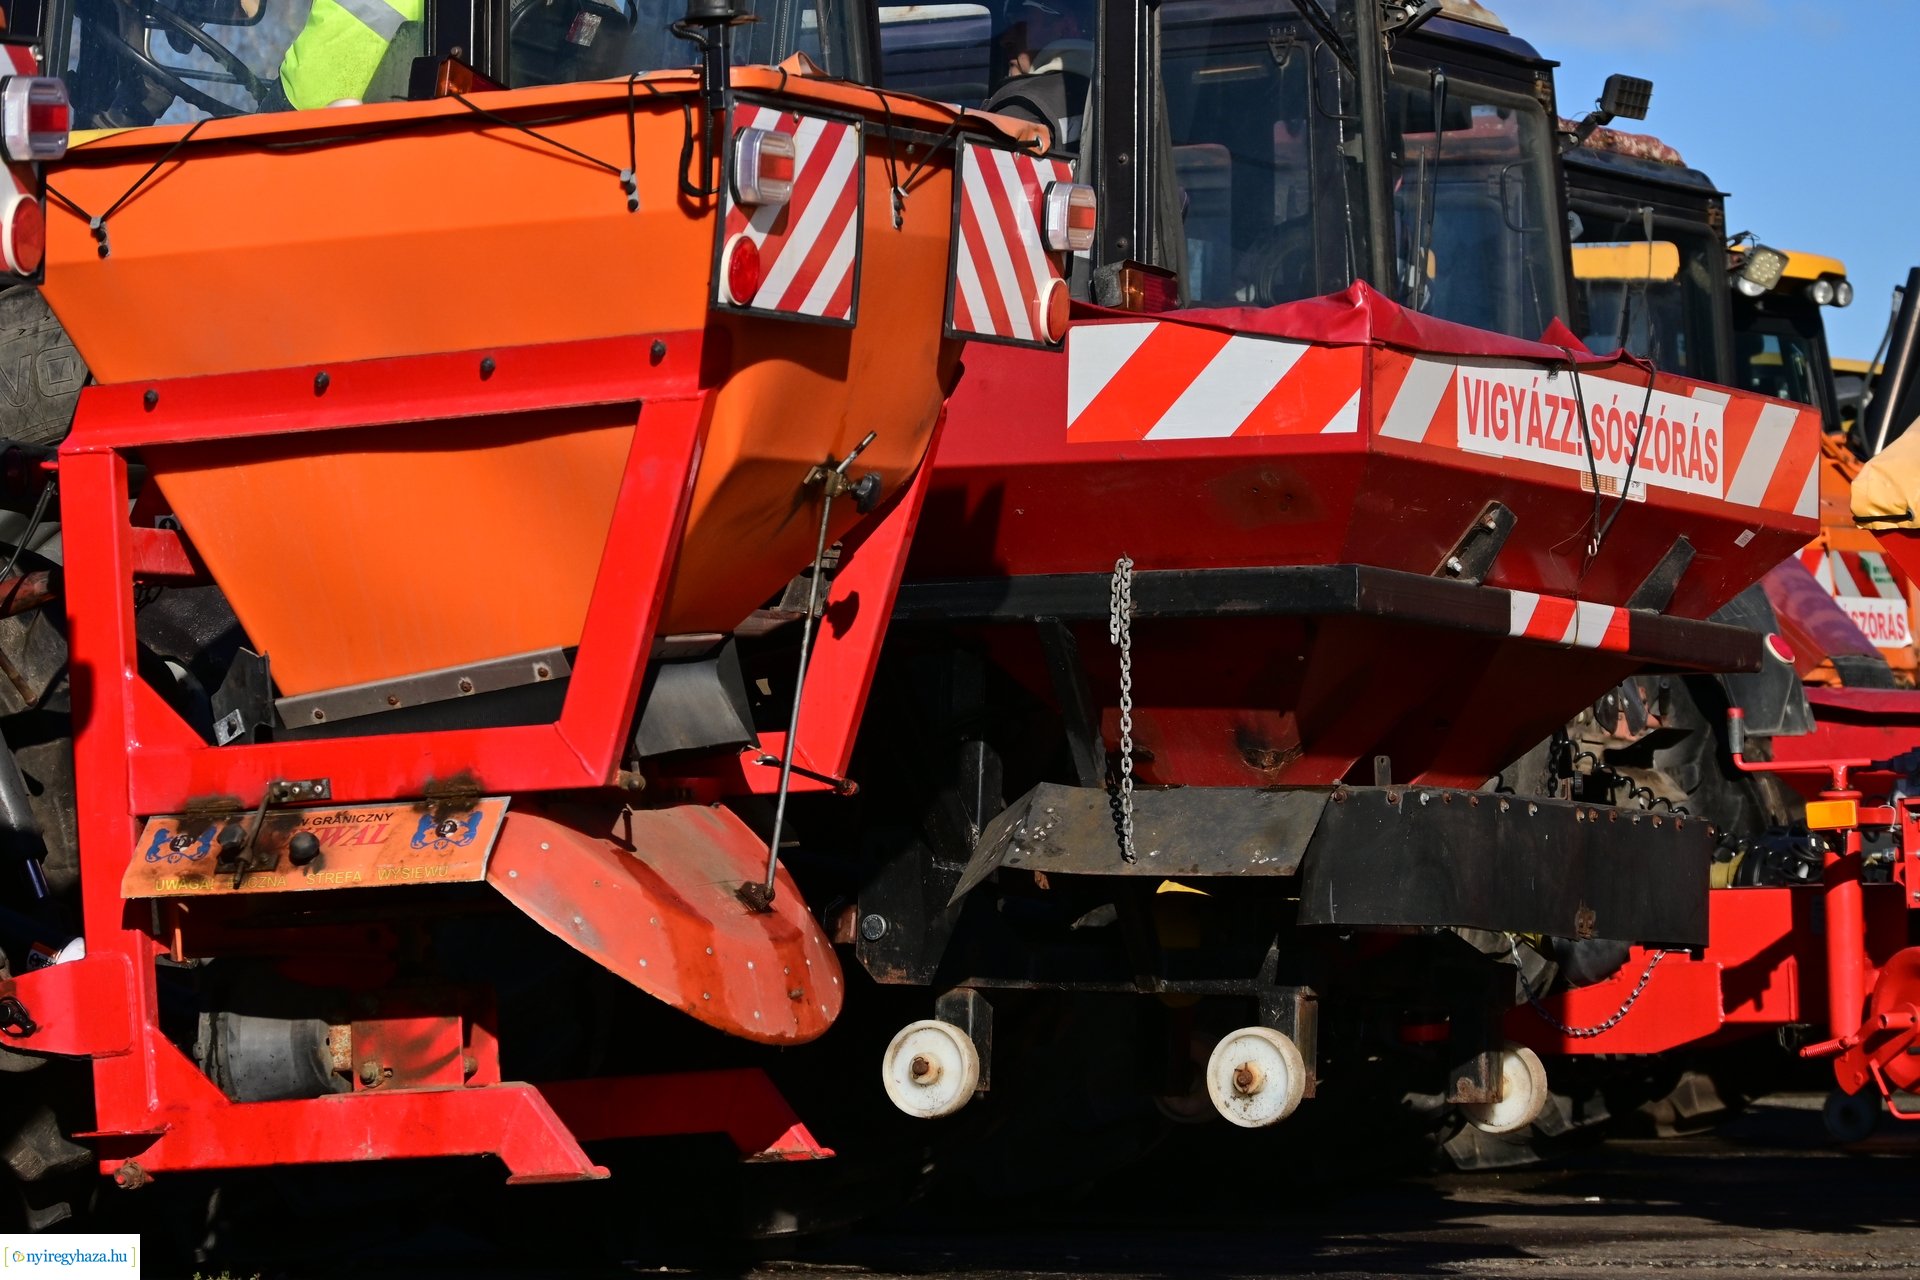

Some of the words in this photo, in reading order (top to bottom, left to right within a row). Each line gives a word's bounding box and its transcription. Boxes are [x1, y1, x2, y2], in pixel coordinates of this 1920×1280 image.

[1462, 376, 1583, 456] VIGYÁZZ!
[1590, 394, 1718, 484] SÓSZÓRÁS
[312, 812, 394, 826] GRANICZNY
[155, 878, 214, 891] UWAGA!
[306, 871, 362, 885] STREFA
[377, 865, 448, 881] WYSIEWU
